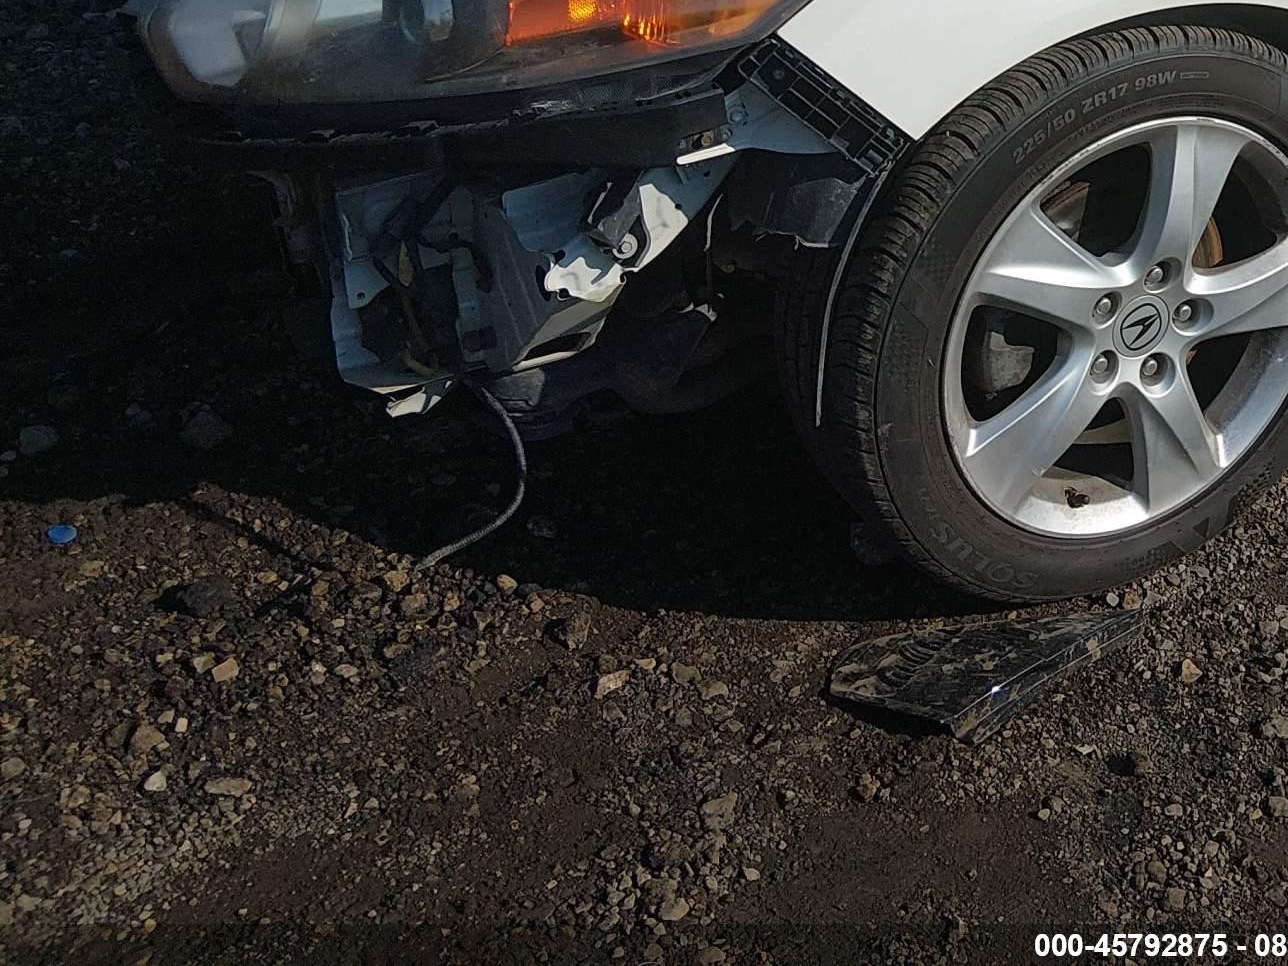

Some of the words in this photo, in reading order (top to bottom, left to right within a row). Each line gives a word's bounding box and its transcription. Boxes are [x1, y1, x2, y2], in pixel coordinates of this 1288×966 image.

[1012, 108, 1076, 164] 225/50
[1081, 82, 1129, 112] ZR17
[1134, 70, 1178, 92] 98W
[928, 521, 1039, 587] SOLUS
